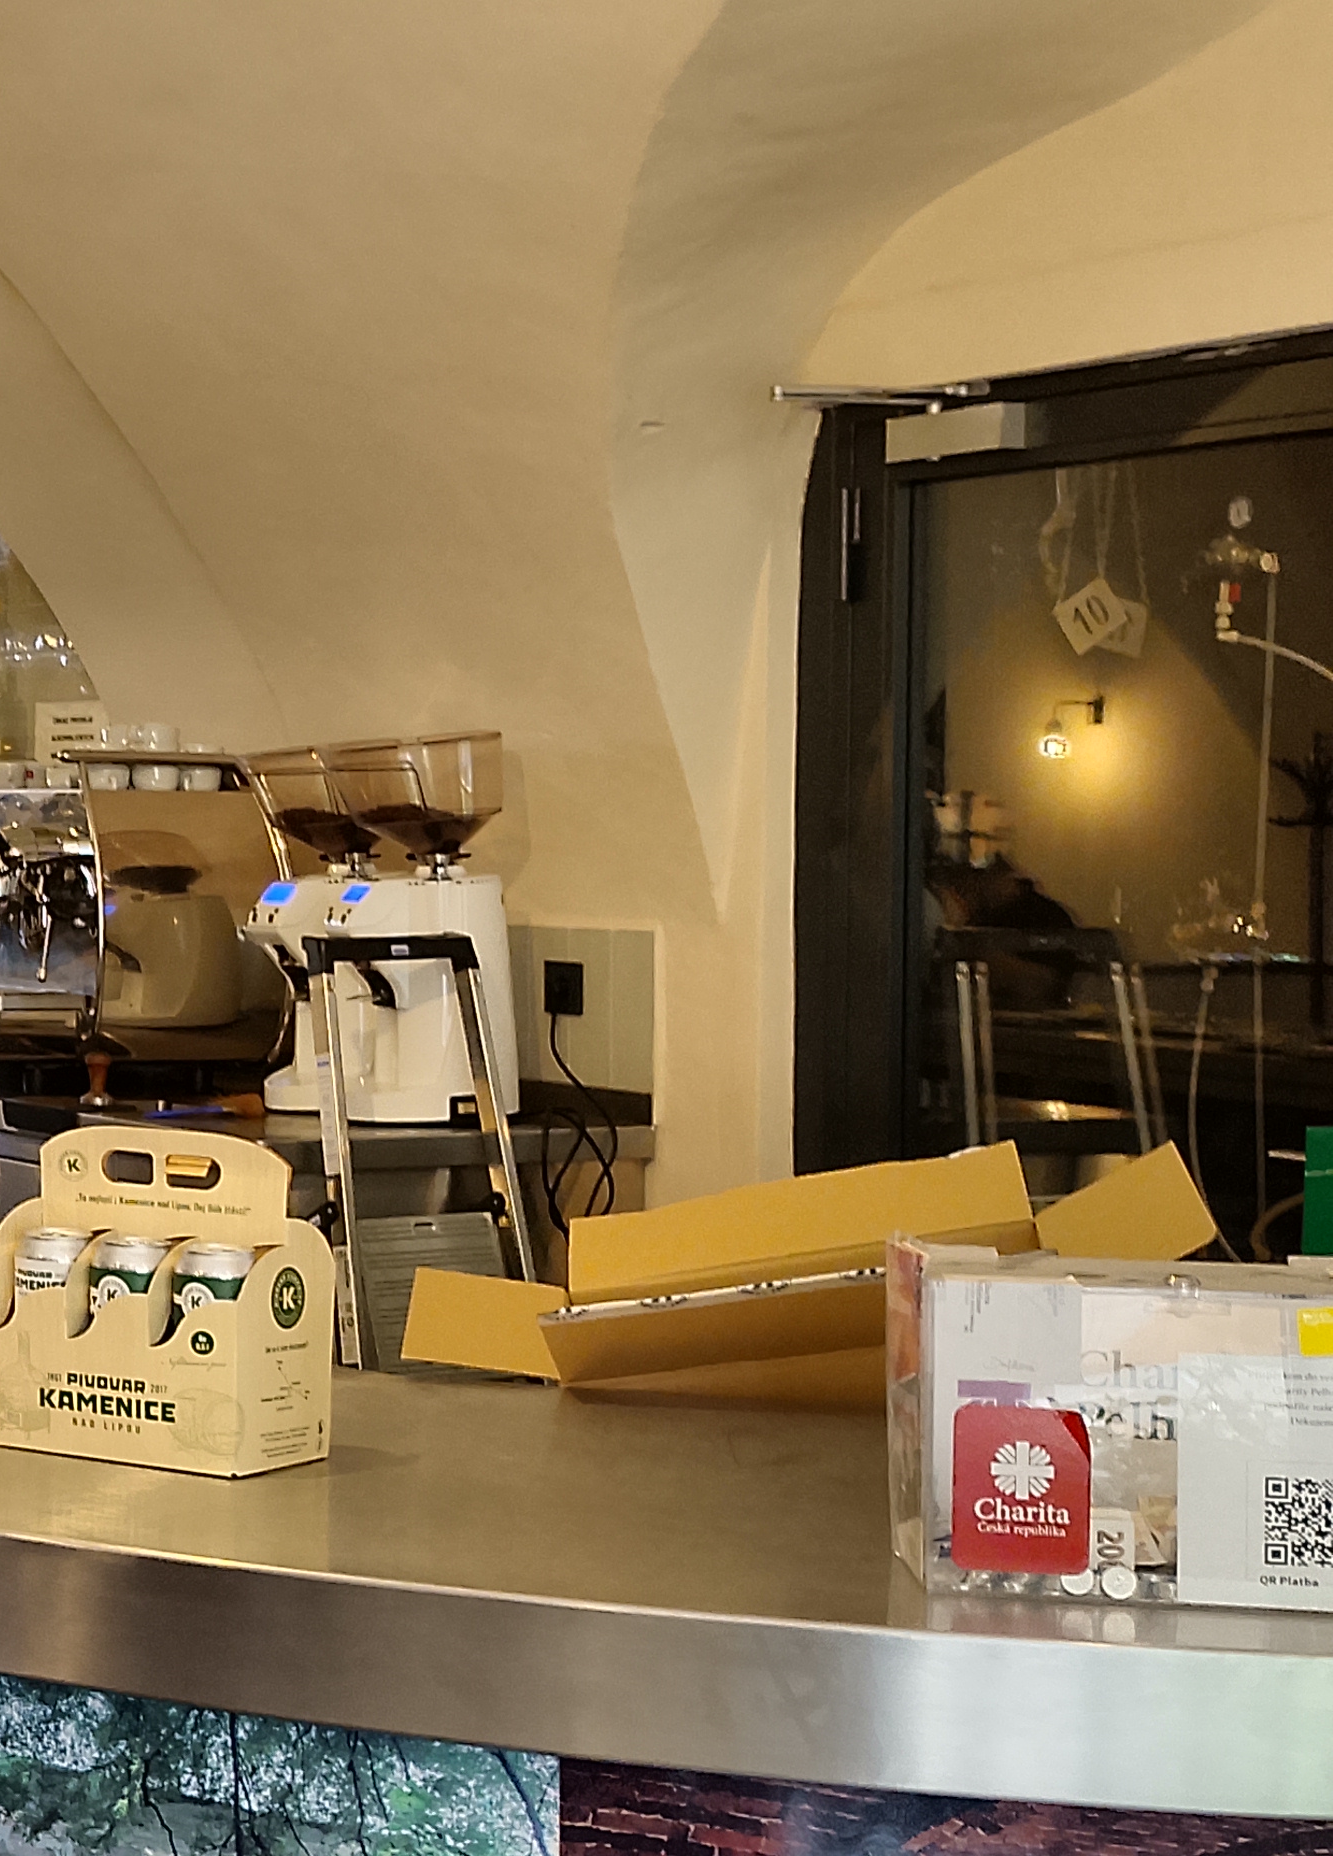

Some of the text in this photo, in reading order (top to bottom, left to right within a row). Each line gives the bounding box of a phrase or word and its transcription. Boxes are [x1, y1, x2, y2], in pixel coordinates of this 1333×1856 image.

[1073, 595, 1109, 635] 10
[67, 1158, 81, 1172] K
[106, 1288, 118, 1302] K
[190, 1295, 202, 1309] K
[282, 1286, 296, 1310] K
[66, 1371, 146, 1394] PIVOVAR
[151, 1383, 167, 1394] 2017
[39, 1387, 176, 1424] KAMENICE
[72, 1416, 95, 1429] NAD
[974, 1498, 1071, 1525] Charita
[977, 1521, 1067, 1538] Česká republika
[1259, 1575, 1320, 1588] QR Platba
